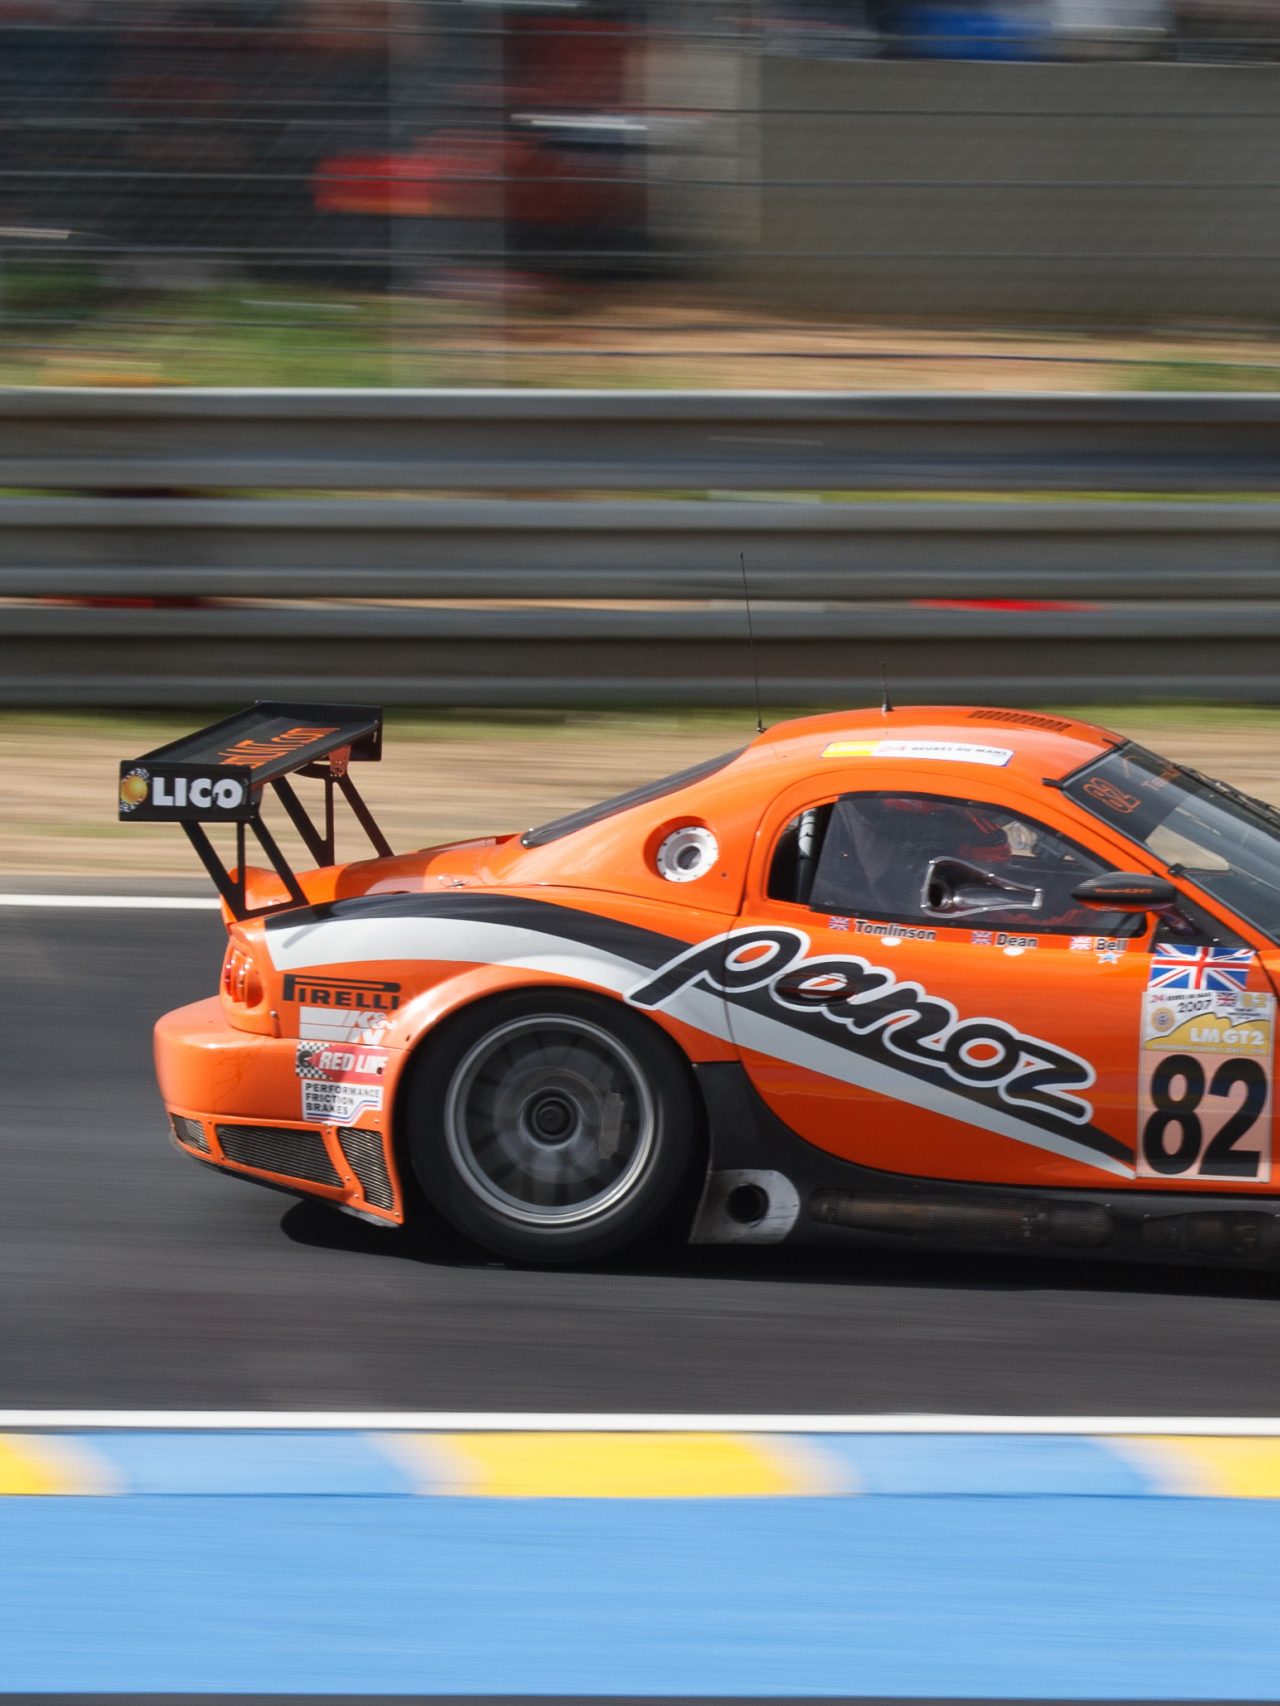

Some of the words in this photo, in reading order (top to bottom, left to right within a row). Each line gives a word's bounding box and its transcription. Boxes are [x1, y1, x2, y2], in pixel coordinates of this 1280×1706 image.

[152, 776, 243, 809] LICO
[855, 919, 937, 942] Tomlinson
[995, 932, 1039, 949] Dean
[1095, 937, 1128, 952] Bell
[282, 973, 402, 1010] PIRELLI
[1177, 999, 1213, 1013] 2007
[319, 1051, 355, 1072] RED
[305, 1083, 380, 1098] PERFORMANCE
[305, 1092, 354, 1106] FRICTION
[305, 1102, 349, 1115] BRAKES
[1142, 1054, 1267, 1178] 82
